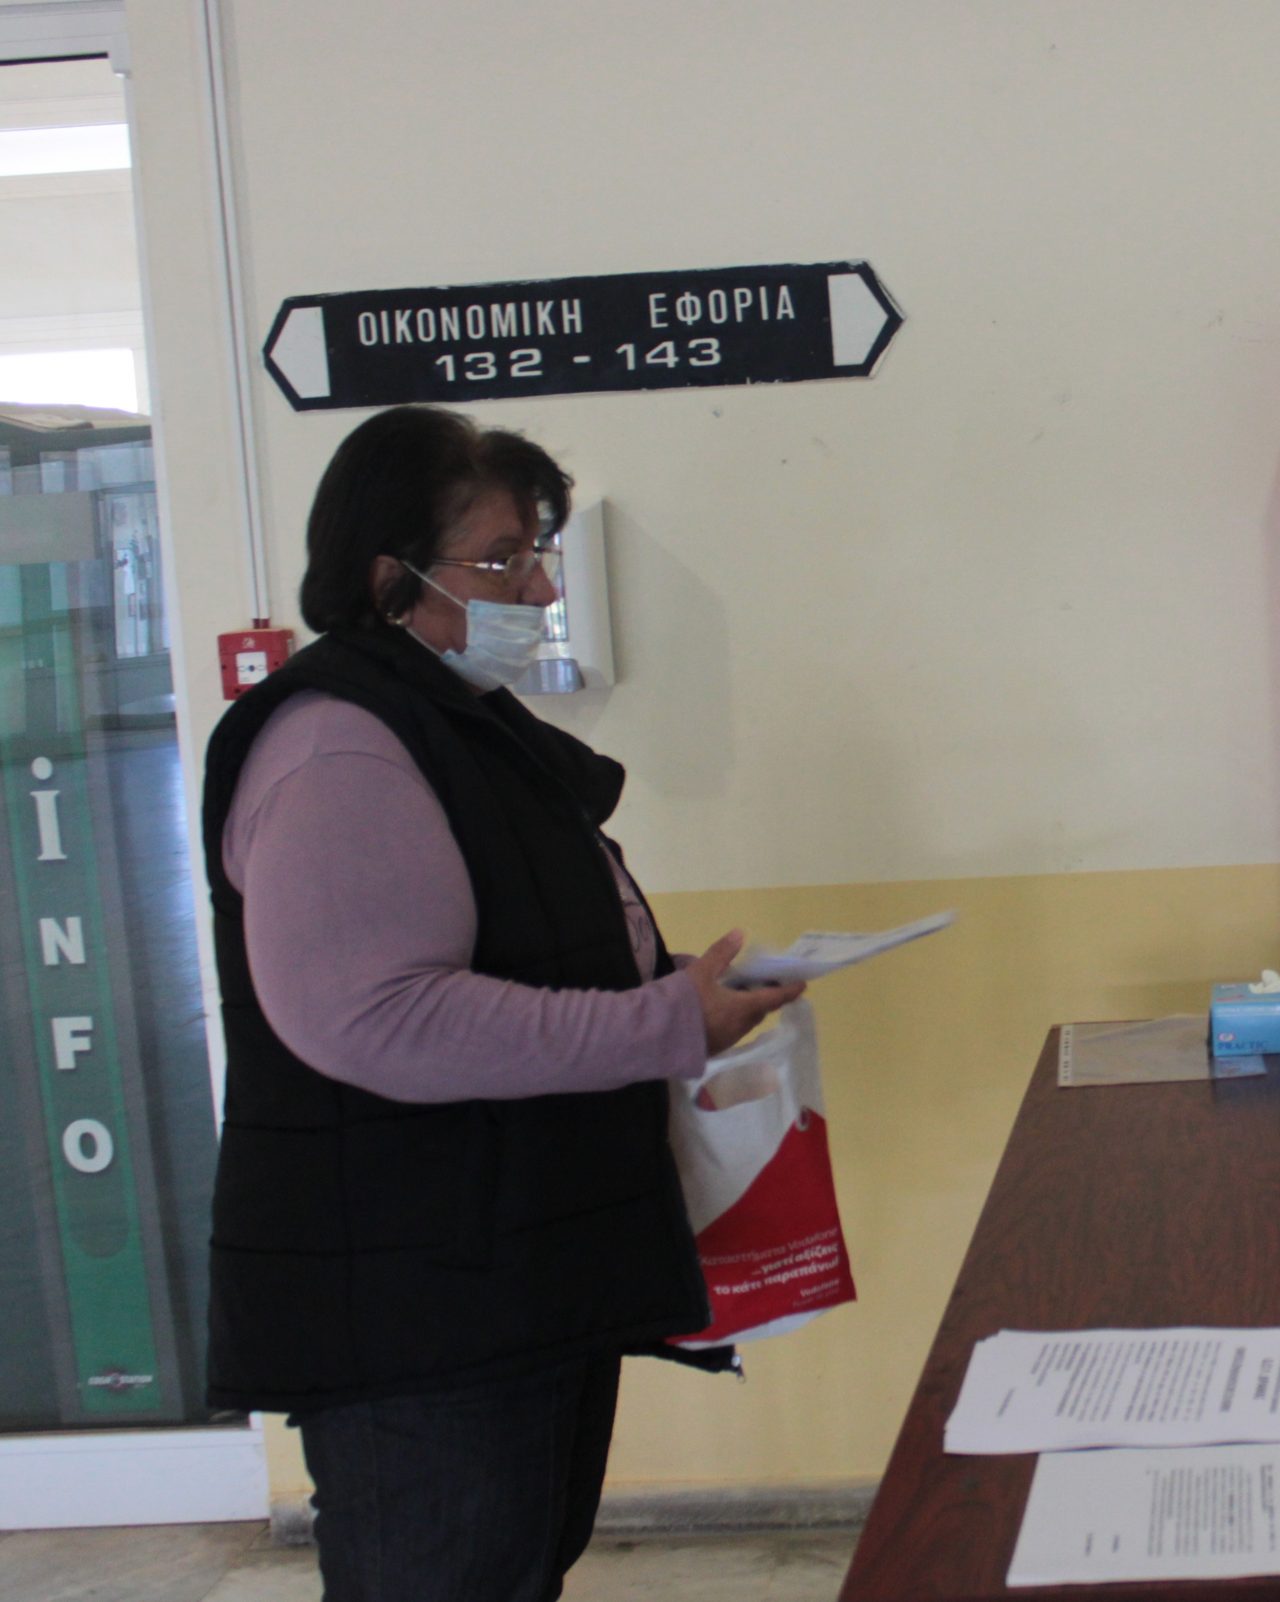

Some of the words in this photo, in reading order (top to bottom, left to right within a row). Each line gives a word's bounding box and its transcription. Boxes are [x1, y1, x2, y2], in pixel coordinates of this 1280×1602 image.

[358, 298, 583, 347] ΟΙΚΟΝΟΜΙΚΗ
[648, 285, 796, 329] ΕΦΟΡΙΑ
[435, 348, 543, 382] 132
[615, 337, 722, 371] 143
